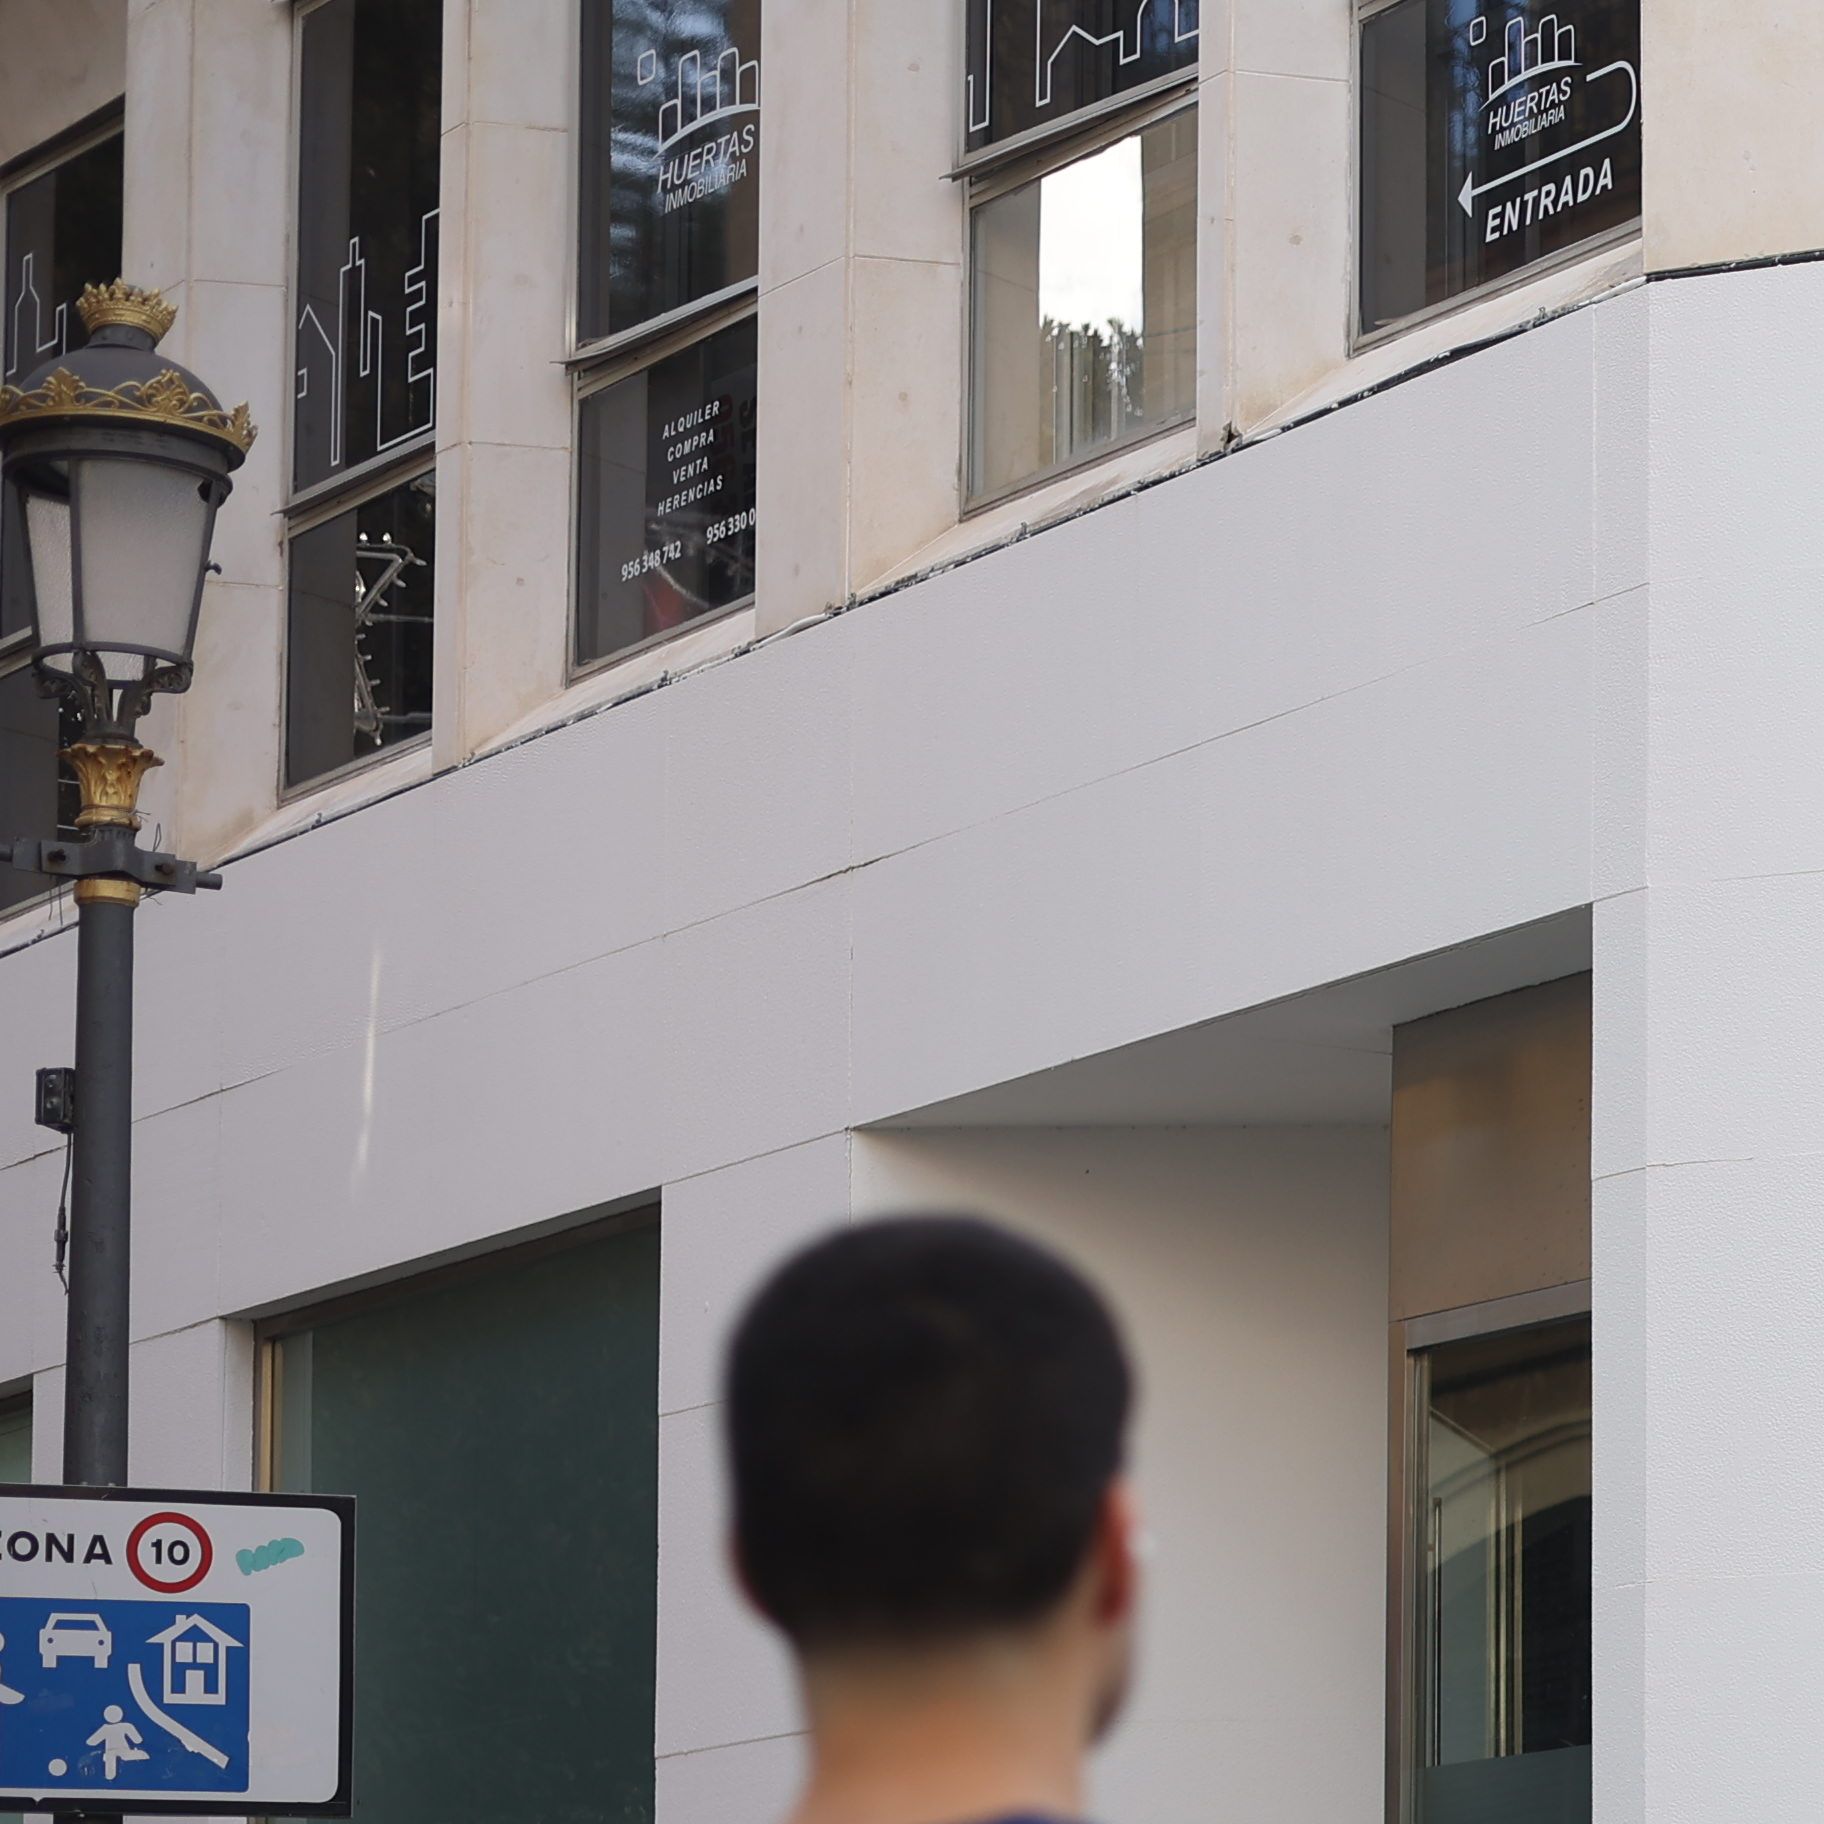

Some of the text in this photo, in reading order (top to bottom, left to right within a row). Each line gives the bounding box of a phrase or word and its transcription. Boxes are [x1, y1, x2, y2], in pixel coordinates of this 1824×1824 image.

[1486, 76, 1572, 134] HUERTAS
[1494, 105, 1566, 151] INMOBILIARIA
[657, 124, 755, 193] HUERTAS
[665, 159, 747, 213] INMOBILIARIA
[1484, 156, 1614, 244] ENTRADA
[662, 400, 720, 440] ALQUILER
[667, 428, 714, 462] COMPRA
[672, 456, 709, 485] VENTA
[657, 475, 723, 517] HERENCIAS
[706, 519, 726, 545] 956
[727, 511, 746, 537] 330
[621, 540, 682, 582] 956 348 742
[0, 1532, 190, 1566] ONA 10
